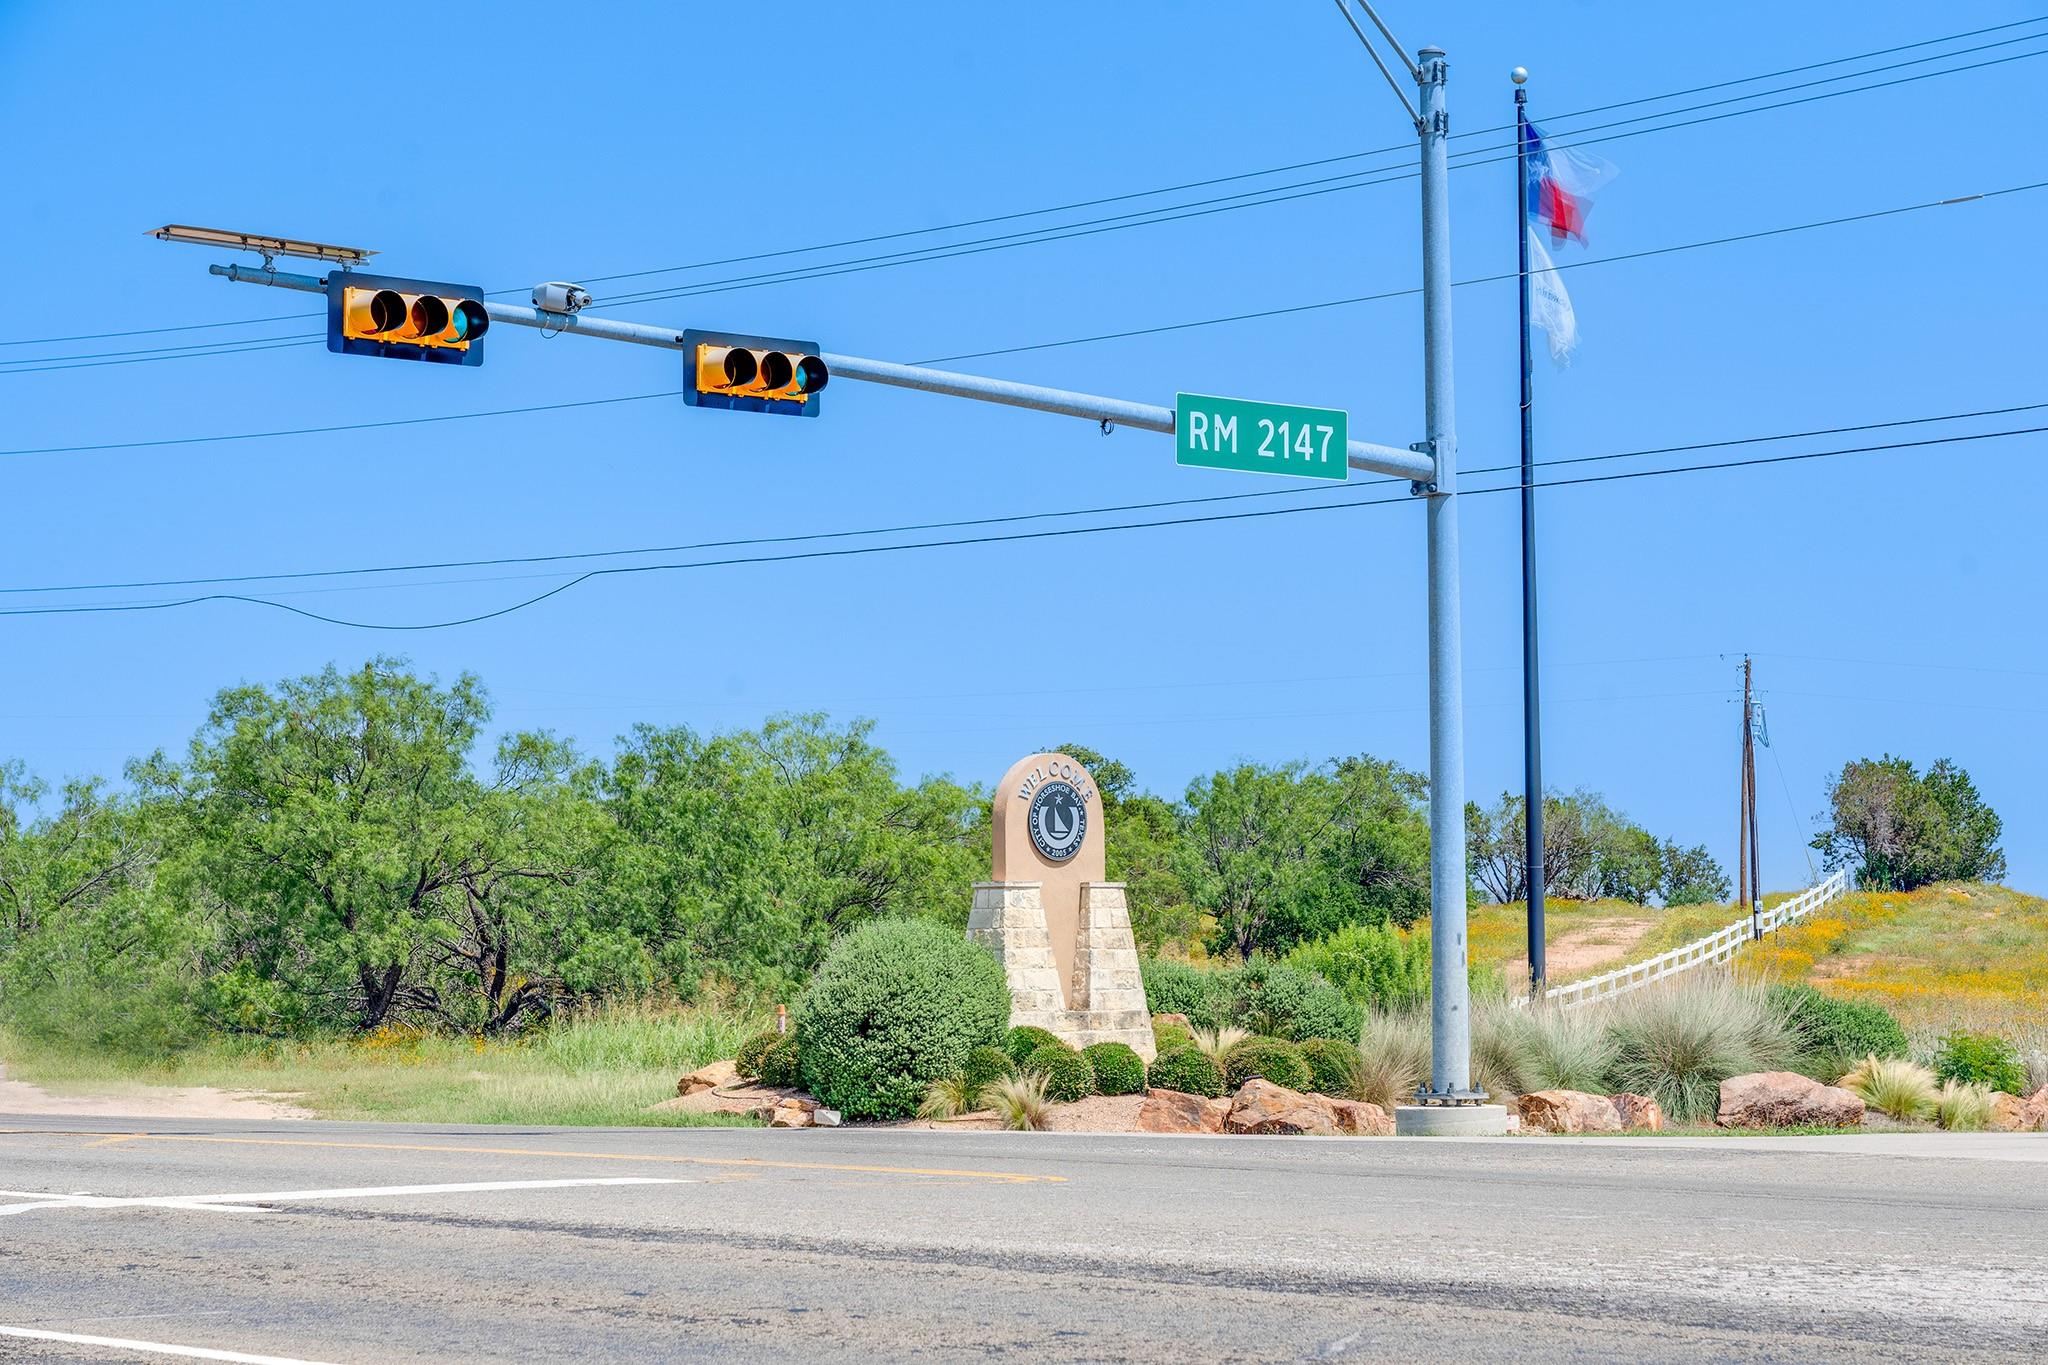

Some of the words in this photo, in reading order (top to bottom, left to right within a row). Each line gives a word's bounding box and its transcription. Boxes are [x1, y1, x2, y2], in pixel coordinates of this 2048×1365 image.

[1189, 411, 1237, 453] RM
[1257, 418, 1334, 462] 2147
[1018, 761, 1093, 803] WELCOME
[1034, 784, 1071, 811] HORSESHOE
[1032, 812, 1038, 825] OF
[1033, 828, 1045, 847] CITY
[1073, 820, 1085, 847] TEXAS
